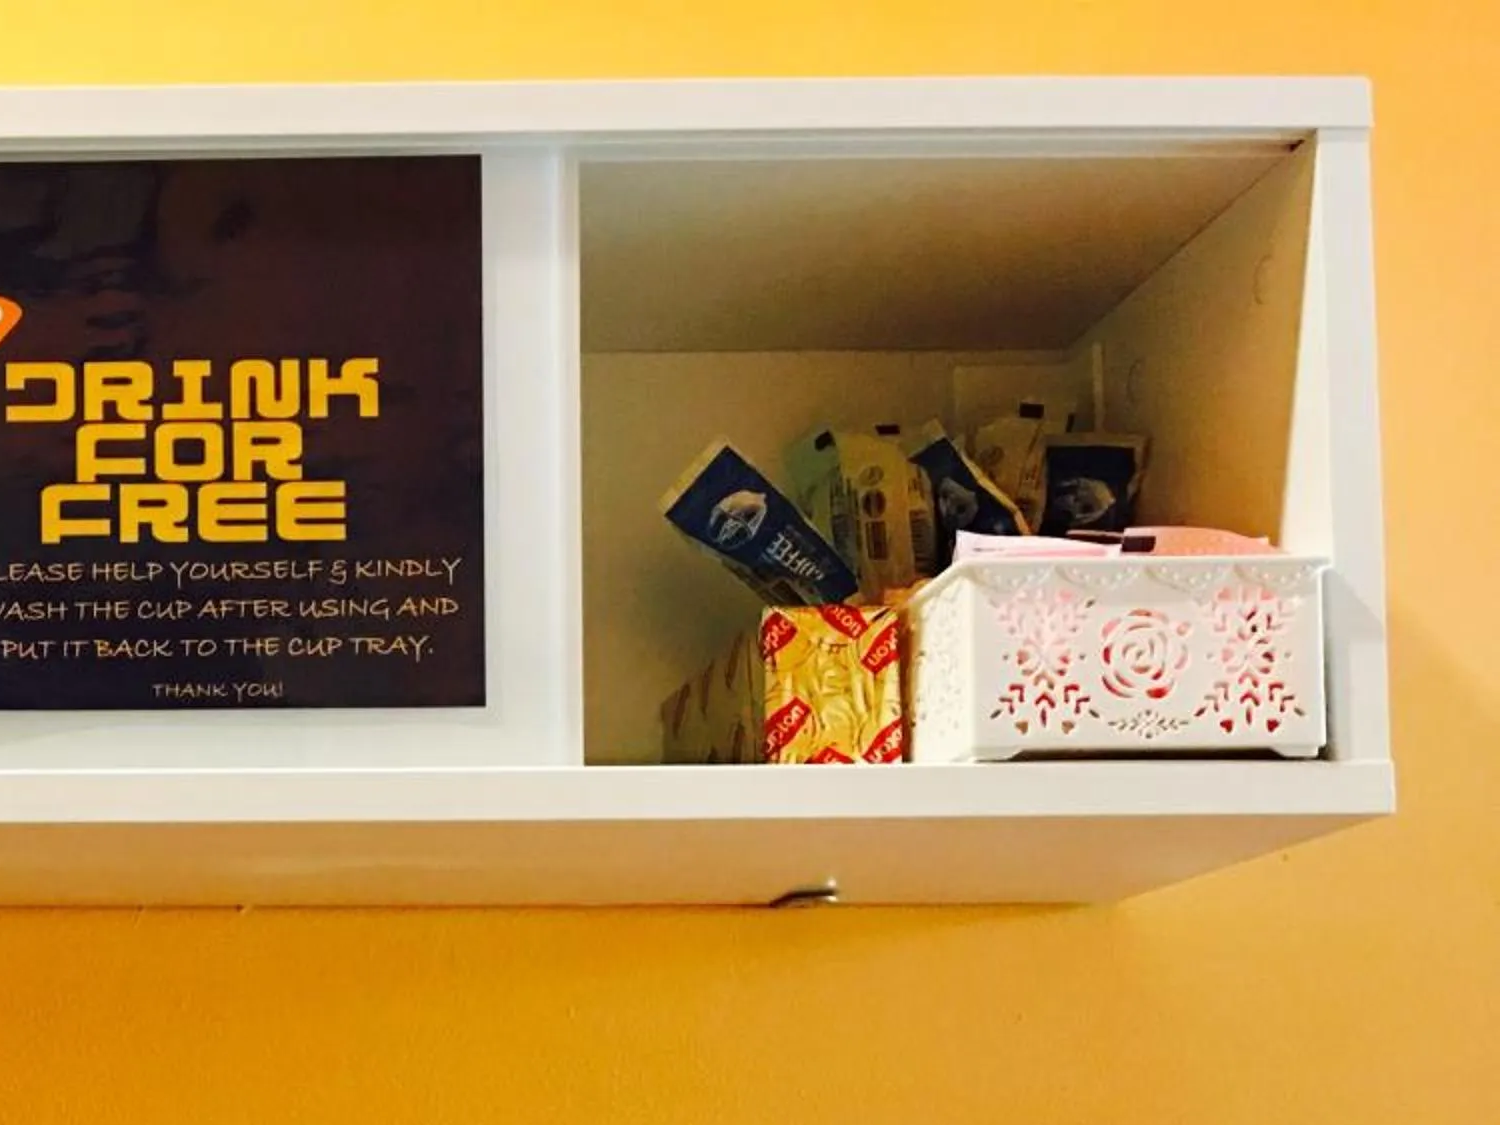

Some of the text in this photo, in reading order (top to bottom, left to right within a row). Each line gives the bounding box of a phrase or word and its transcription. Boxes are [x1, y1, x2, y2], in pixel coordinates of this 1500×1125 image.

[5, 357, 379, 422] DRINK
[76, 420, 303, 482] FOR
[41, 480, 346, 544] FREE
[91, 561, 163, 582] HELP
[169, 559, 323, 589] YOURSELF
[330, 559, 348, 585] &
[355, 557, 462, 585] KINDLY
[74, 601, 130, 620] THE
[137, 600, 192, 621] CUP
[197, 599, 292, 619] AFTER
[299, 598, 389, 621] USING
[396, 597, 459, 616] AND
[1, 635, 434, 663] PUT IT BACK TO THE CUP TRAY.
[152, 680, 284, 703] THANK YOU!
